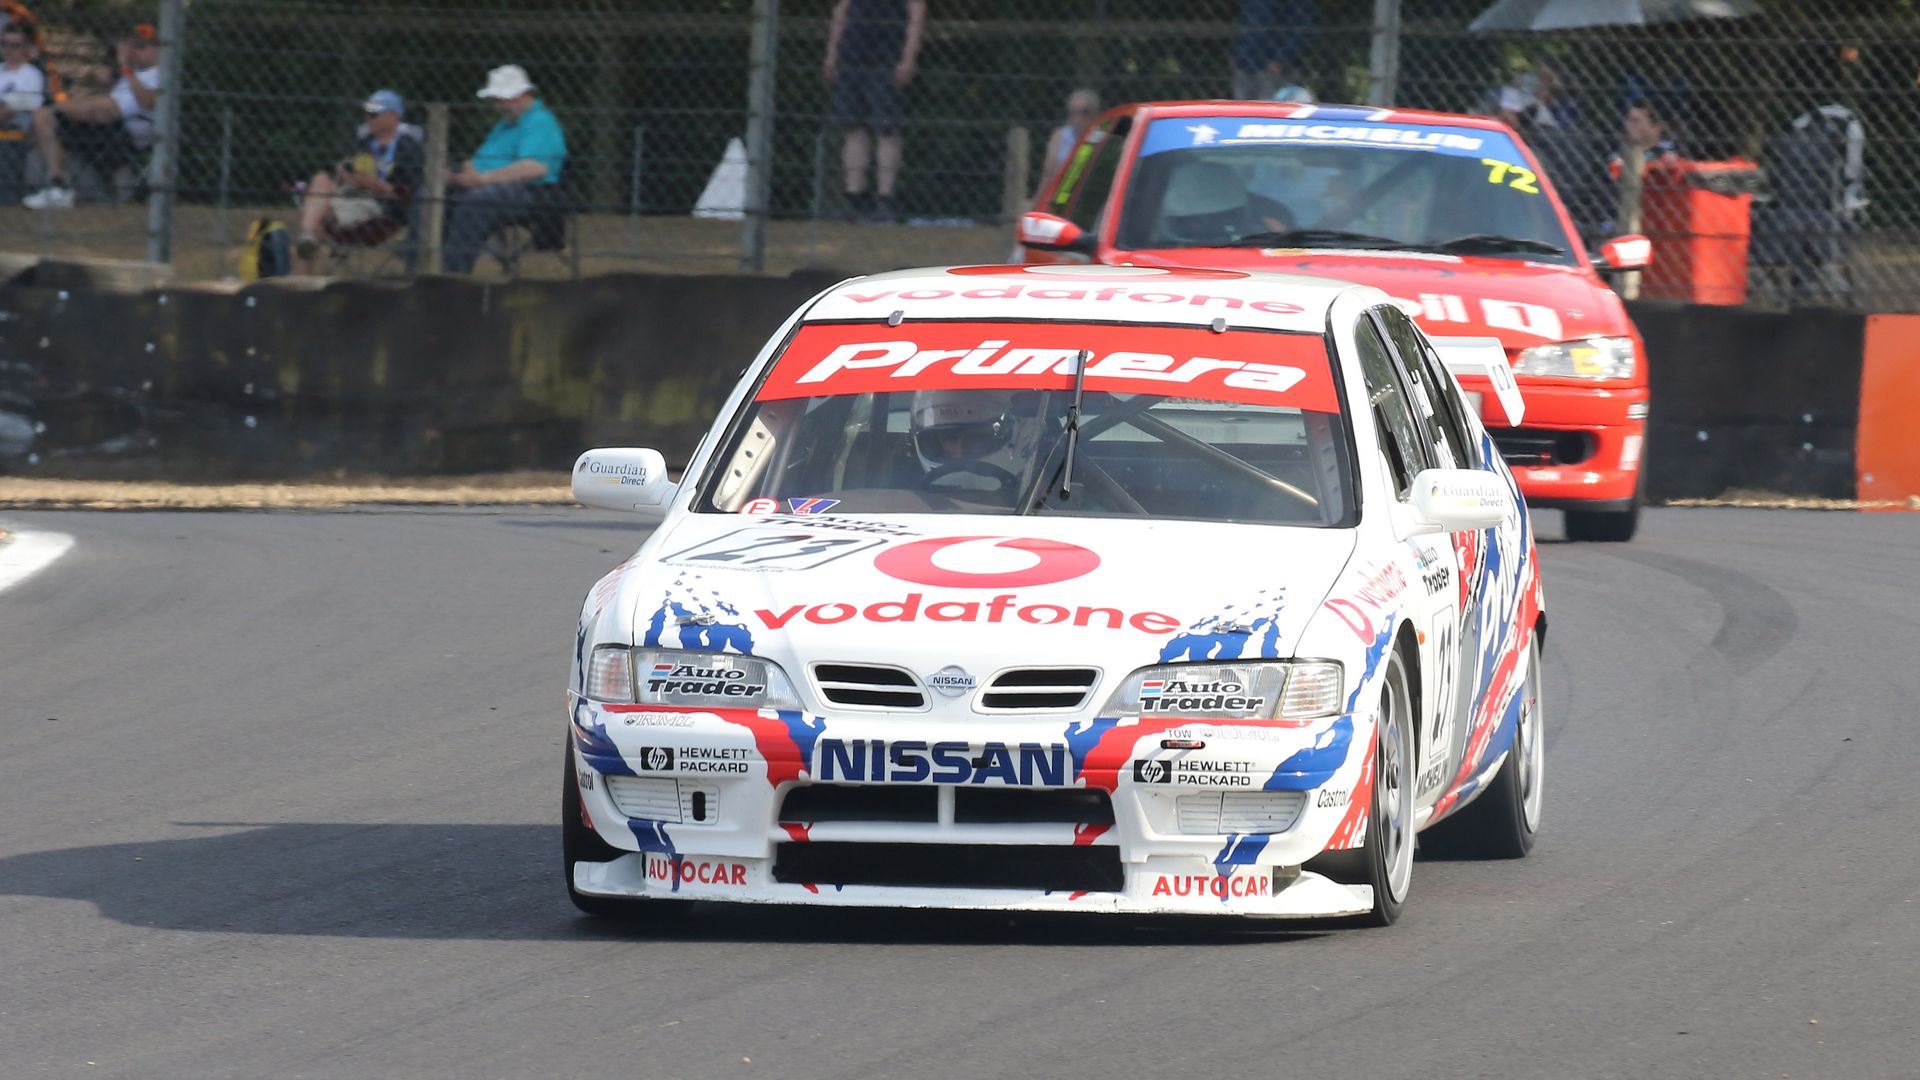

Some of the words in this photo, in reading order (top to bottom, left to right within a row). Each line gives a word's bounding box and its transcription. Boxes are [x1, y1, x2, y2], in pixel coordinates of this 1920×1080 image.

[1237, 125, 1484, 151] MICHELIN
[1482, 158, 1540, 194] 72
[842, 285, 1305, 314] vodafone
[795, 340, 1307, 392] Primera
[589, 463, 647, 477] Guardian
[620, 475, 646, 486] Direct
[1480, 498, 1504, 508] Direct
[754, 593, 1181, 635] vodafone
[670, 664, 745, 680] Auto
[647, 679, 765, 698] Trader
[933, 676, 973, 686] NISSAN
[1163, 682, 1242, 693] Auto
[1139, 695, 1265, 711] Trader
[1167, 728, 1193, 739] TOW
[651, 749, 668, 769] hp
[680, 747, 749, 759] HEWLETT
[680, 761, 749, 773] PACKARD
[820, 738, 1065, 786] NISSAN
[1144, 759, 1161, 782] hp
[1178, 760, 1251, 772] HEWLETT
[1178, 775, 1251, 786] PACKARD
[1317, 789, 1350, 808] Castrol
[649, 859, 747, 885] AUTOCAR
[1152, 876, 1268, 897] AUTOCAR
